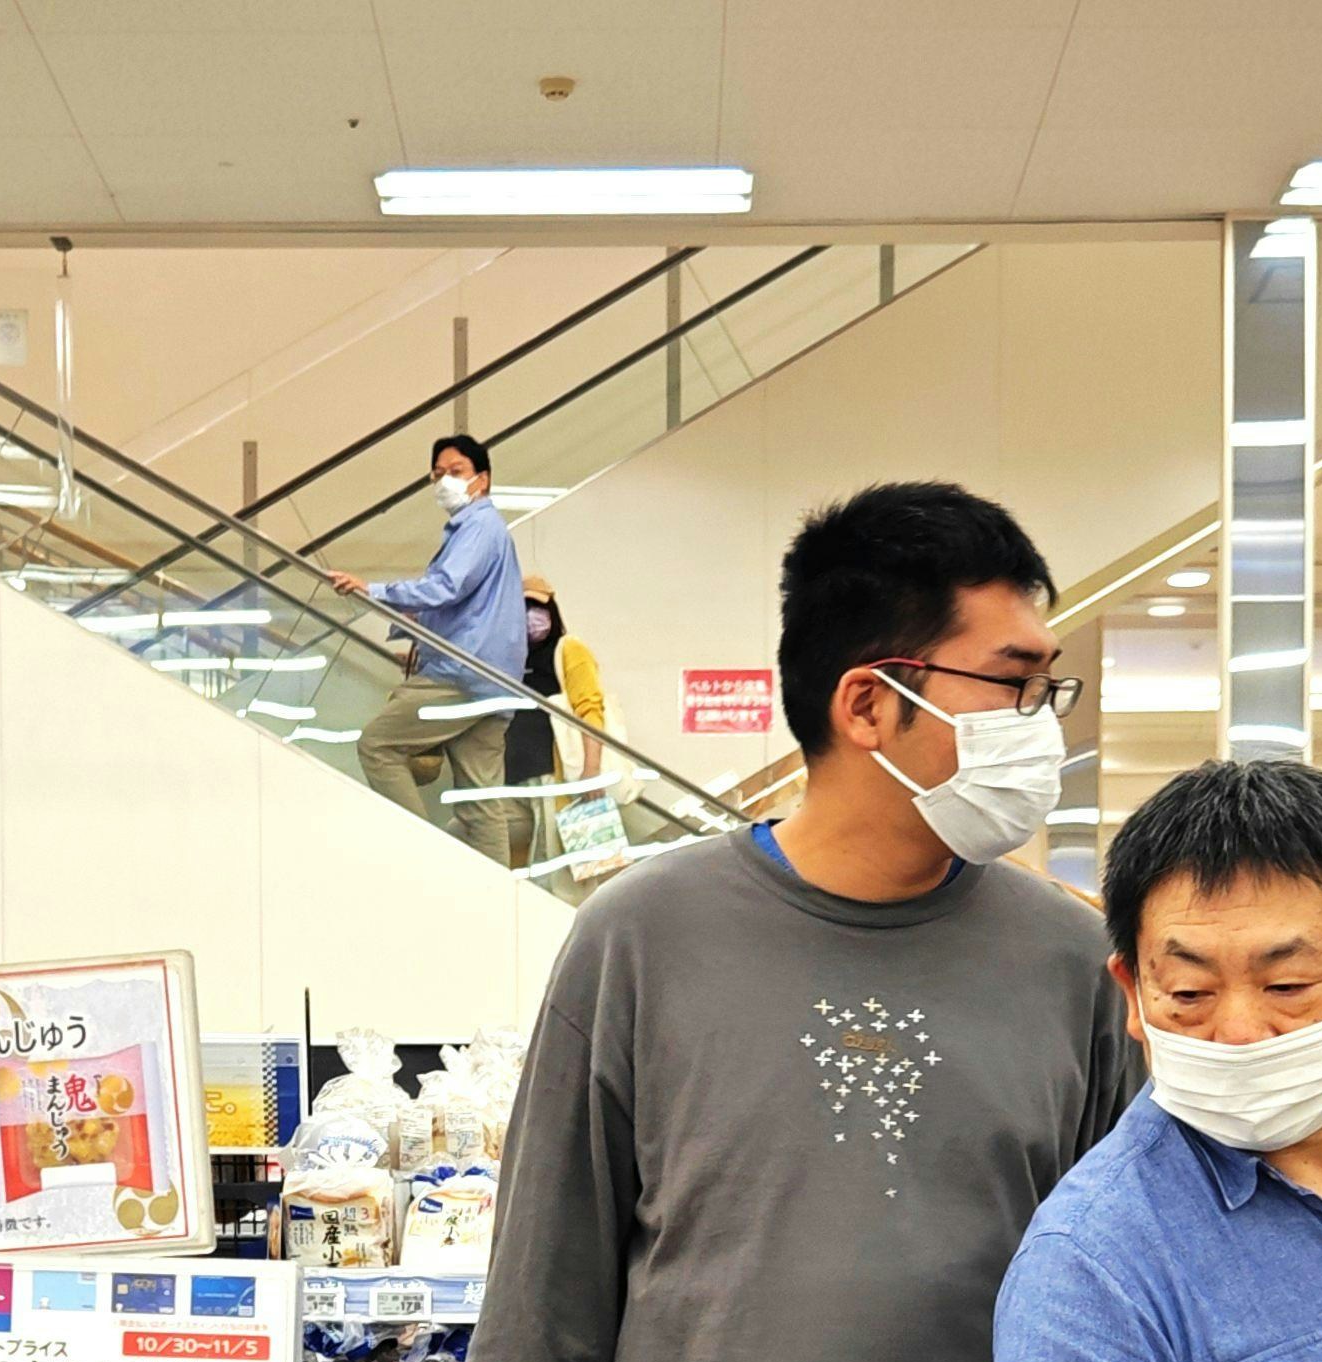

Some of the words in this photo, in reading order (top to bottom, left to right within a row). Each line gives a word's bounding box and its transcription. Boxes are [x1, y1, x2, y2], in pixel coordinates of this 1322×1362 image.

[45, 1075, 70, 1161] まんじゅう
[64, 1073, 98, 1113] 鬼
[321, 1209, 343, 1267] 国産小
